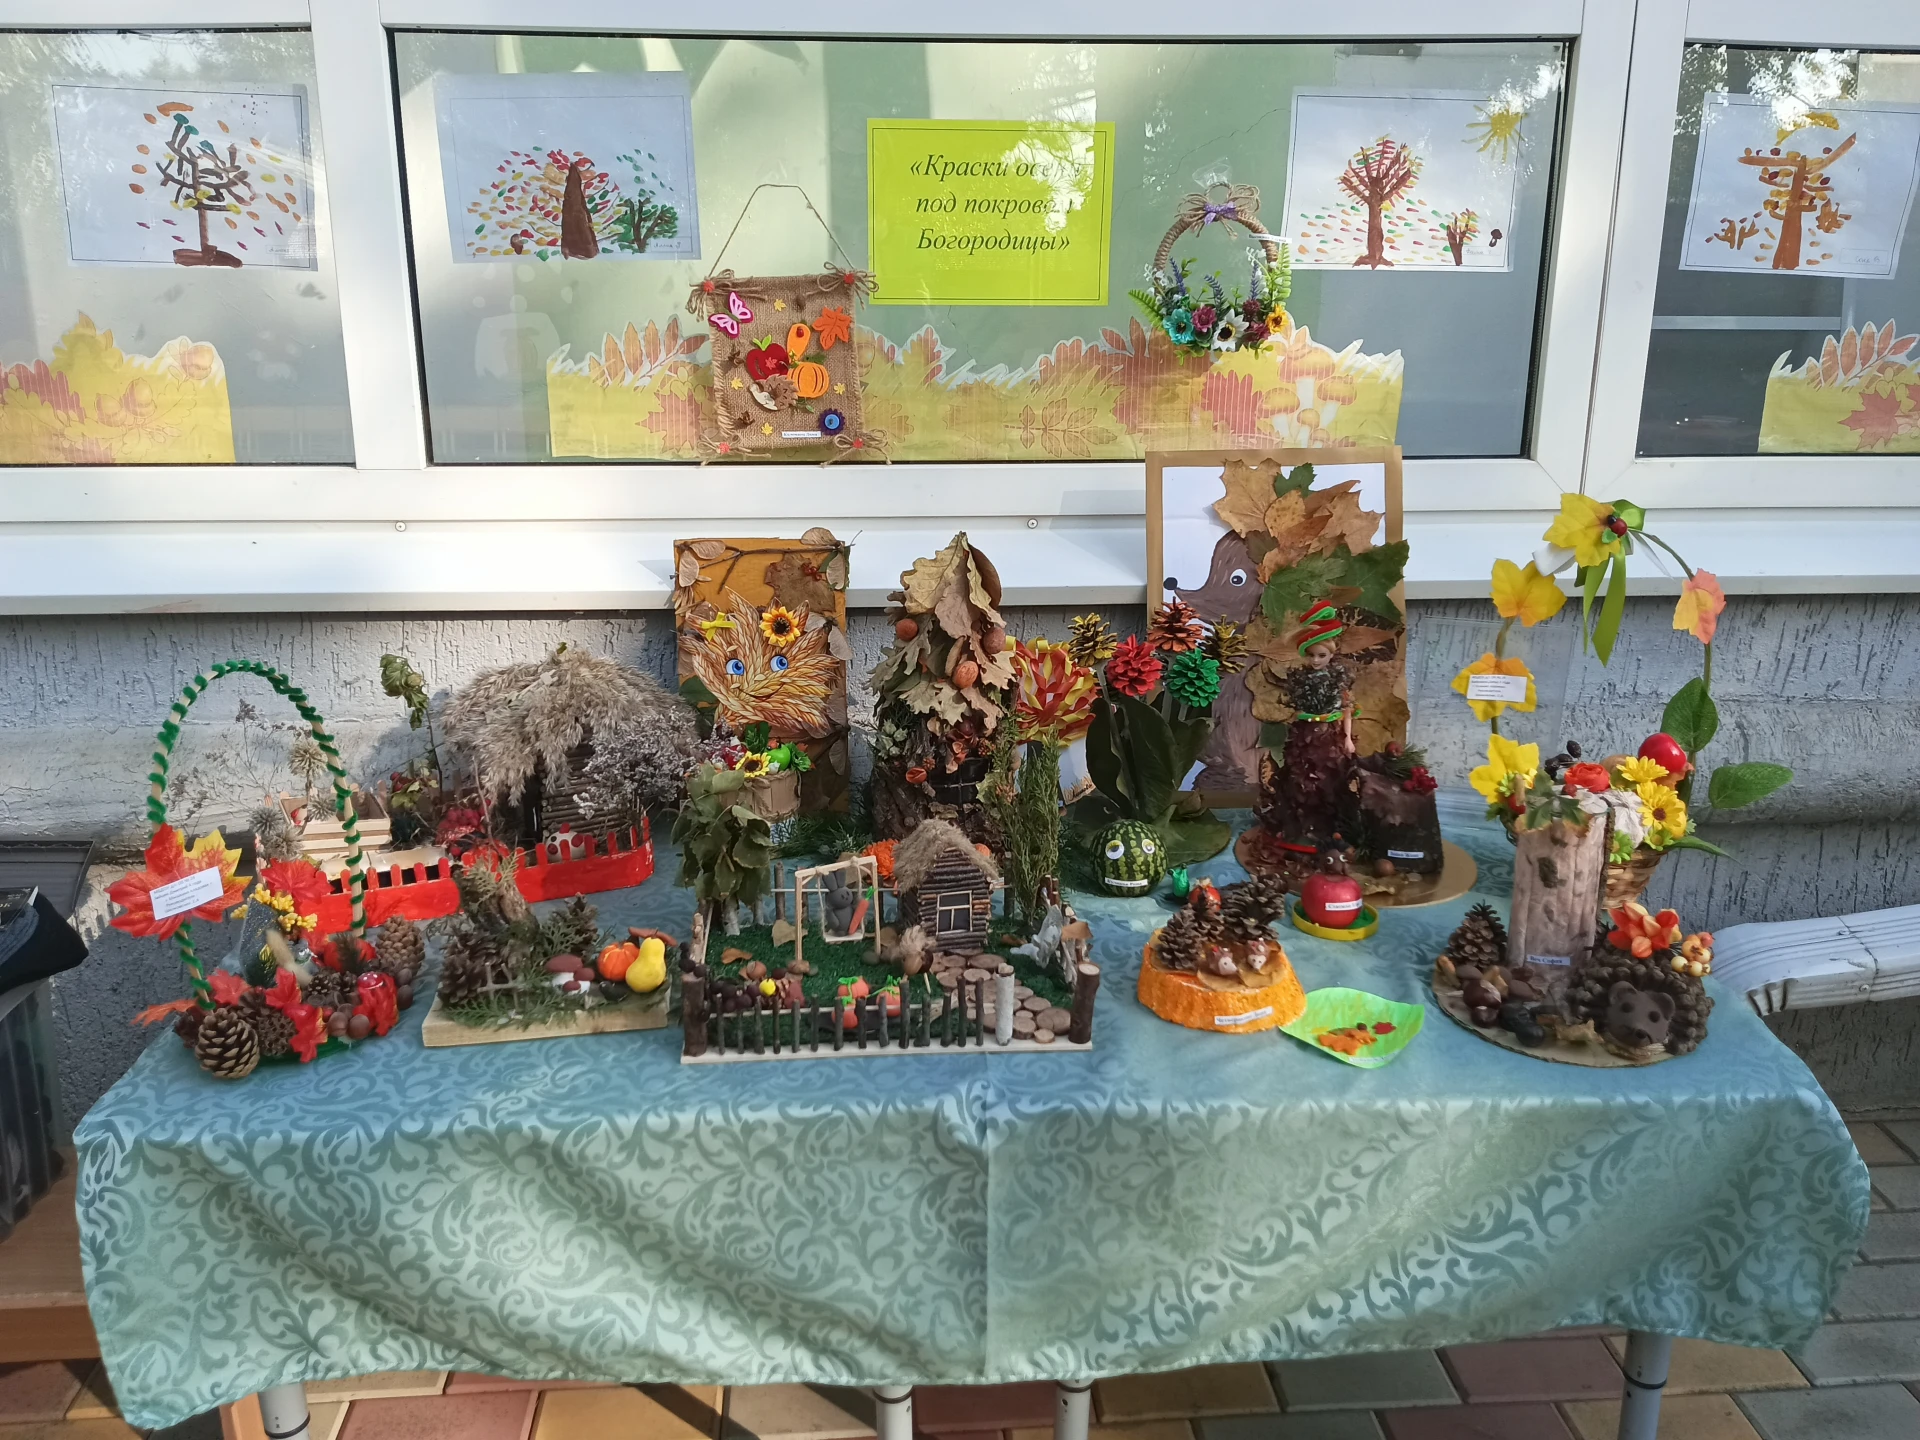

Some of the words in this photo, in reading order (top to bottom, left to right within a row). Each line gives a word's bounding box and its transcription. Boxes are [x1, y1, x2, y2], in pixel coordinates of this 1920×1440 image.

[910, 154, 1008, 182] «Краски
[1015, 162, 1081, 178] осе
[915, 191, 957, 213] под
[916, 227, 1070, 255] Богородицы»
